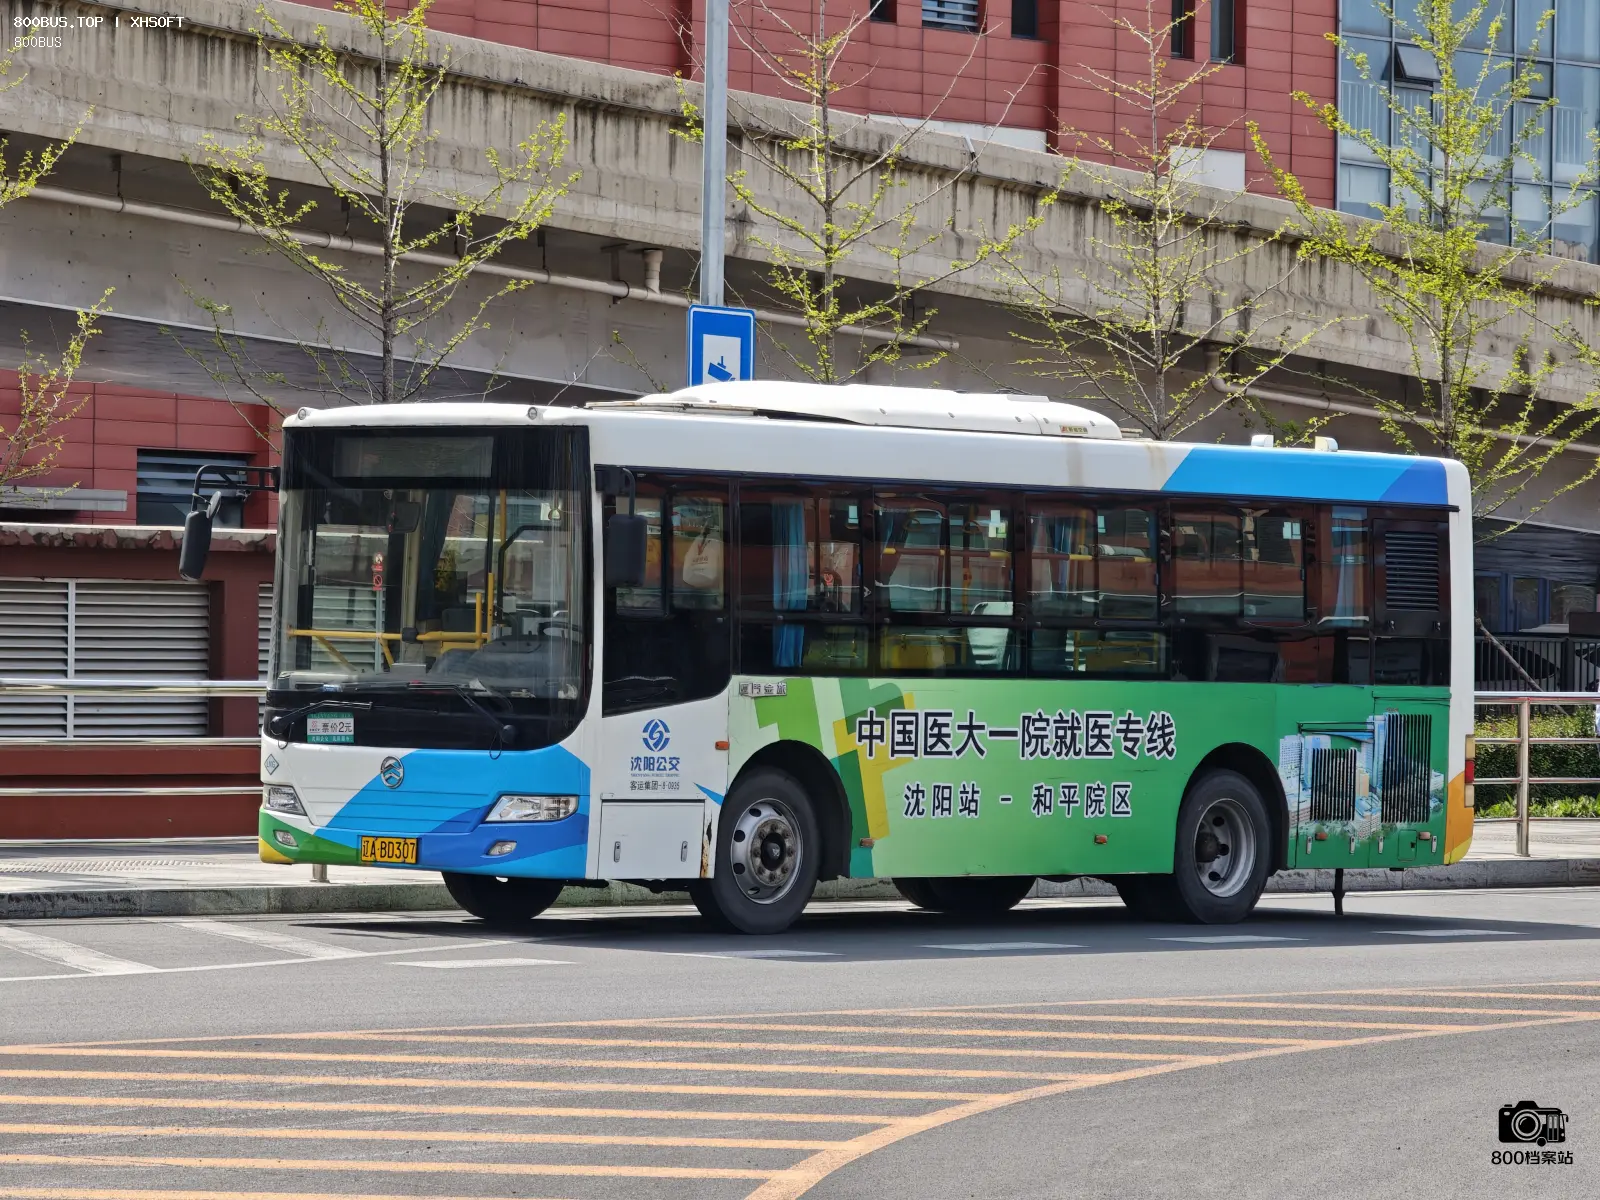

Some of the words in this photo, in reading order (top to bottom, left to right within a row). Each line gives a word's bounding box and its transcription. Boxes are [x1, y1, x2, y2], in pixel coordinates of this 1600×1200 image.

[321, 721, 353, 734] 票价2元
[857, 709, 1177, 759] 中国医大一院就医专线
[630, 756, 680, 771] 沈阳公交
[902, 782, 981, 818] 沈阳站
[1031, 782, 1132, 818] 和平院区
